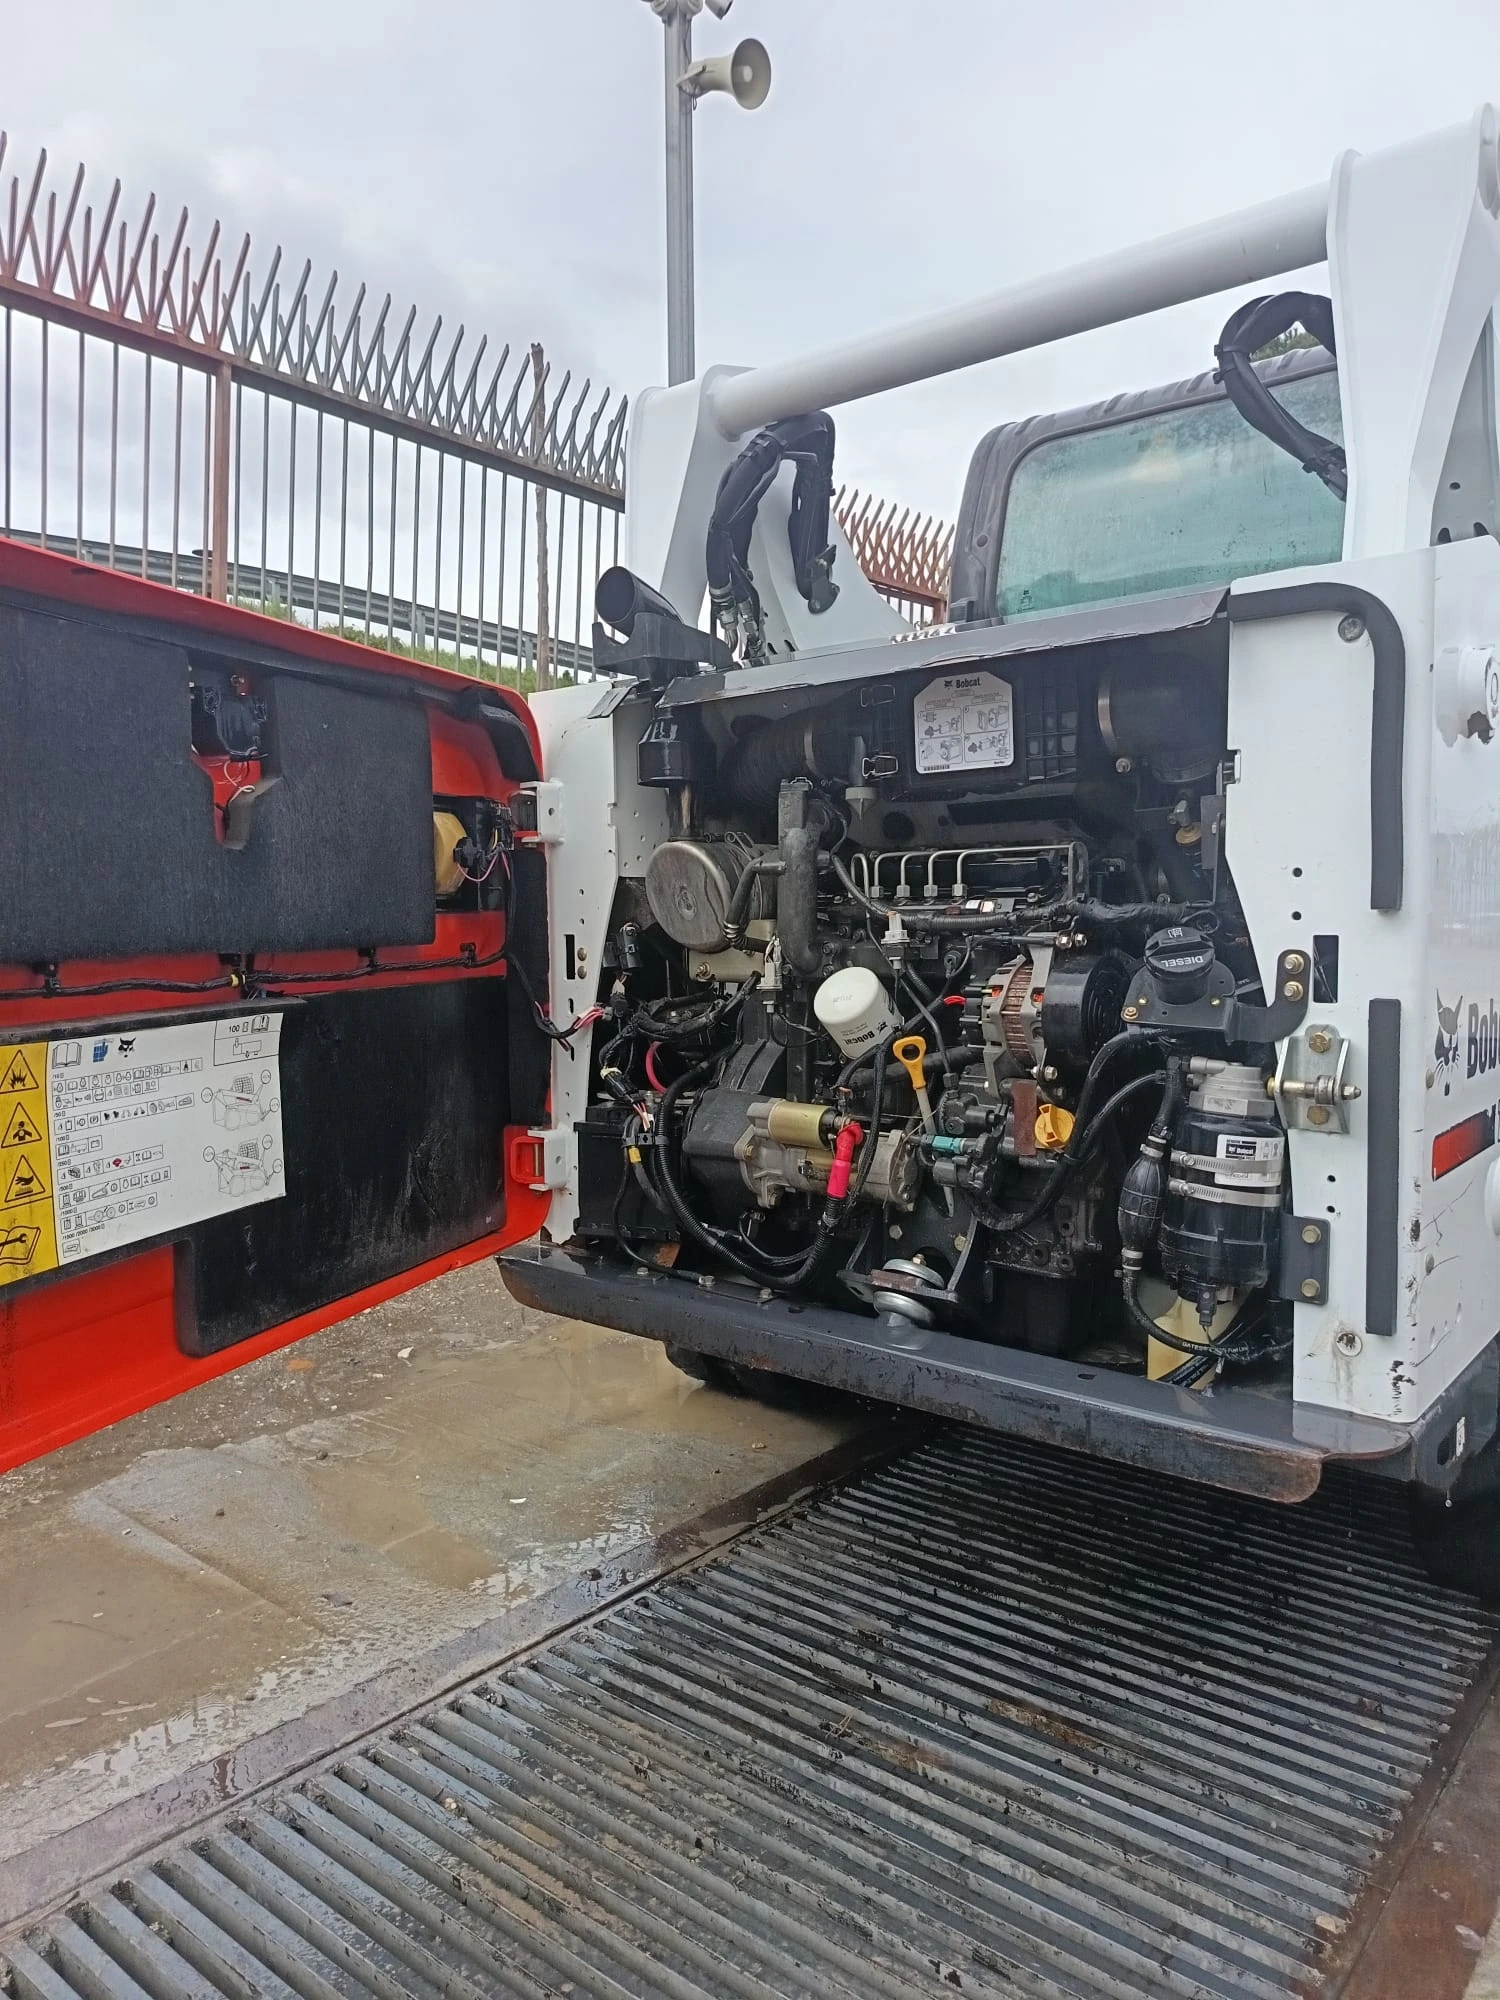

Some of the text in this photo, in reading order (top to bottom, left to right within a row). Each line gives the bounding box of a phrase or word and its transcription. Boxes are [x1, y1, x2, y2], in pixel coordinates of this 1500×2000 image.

[956, 677, 981, 688] Bobcat
[1161, 956, 1204, 967] DIESEL
[229, 1025, 240, 1033] 100
[844, 1030, 875, 1045] Bobcat
